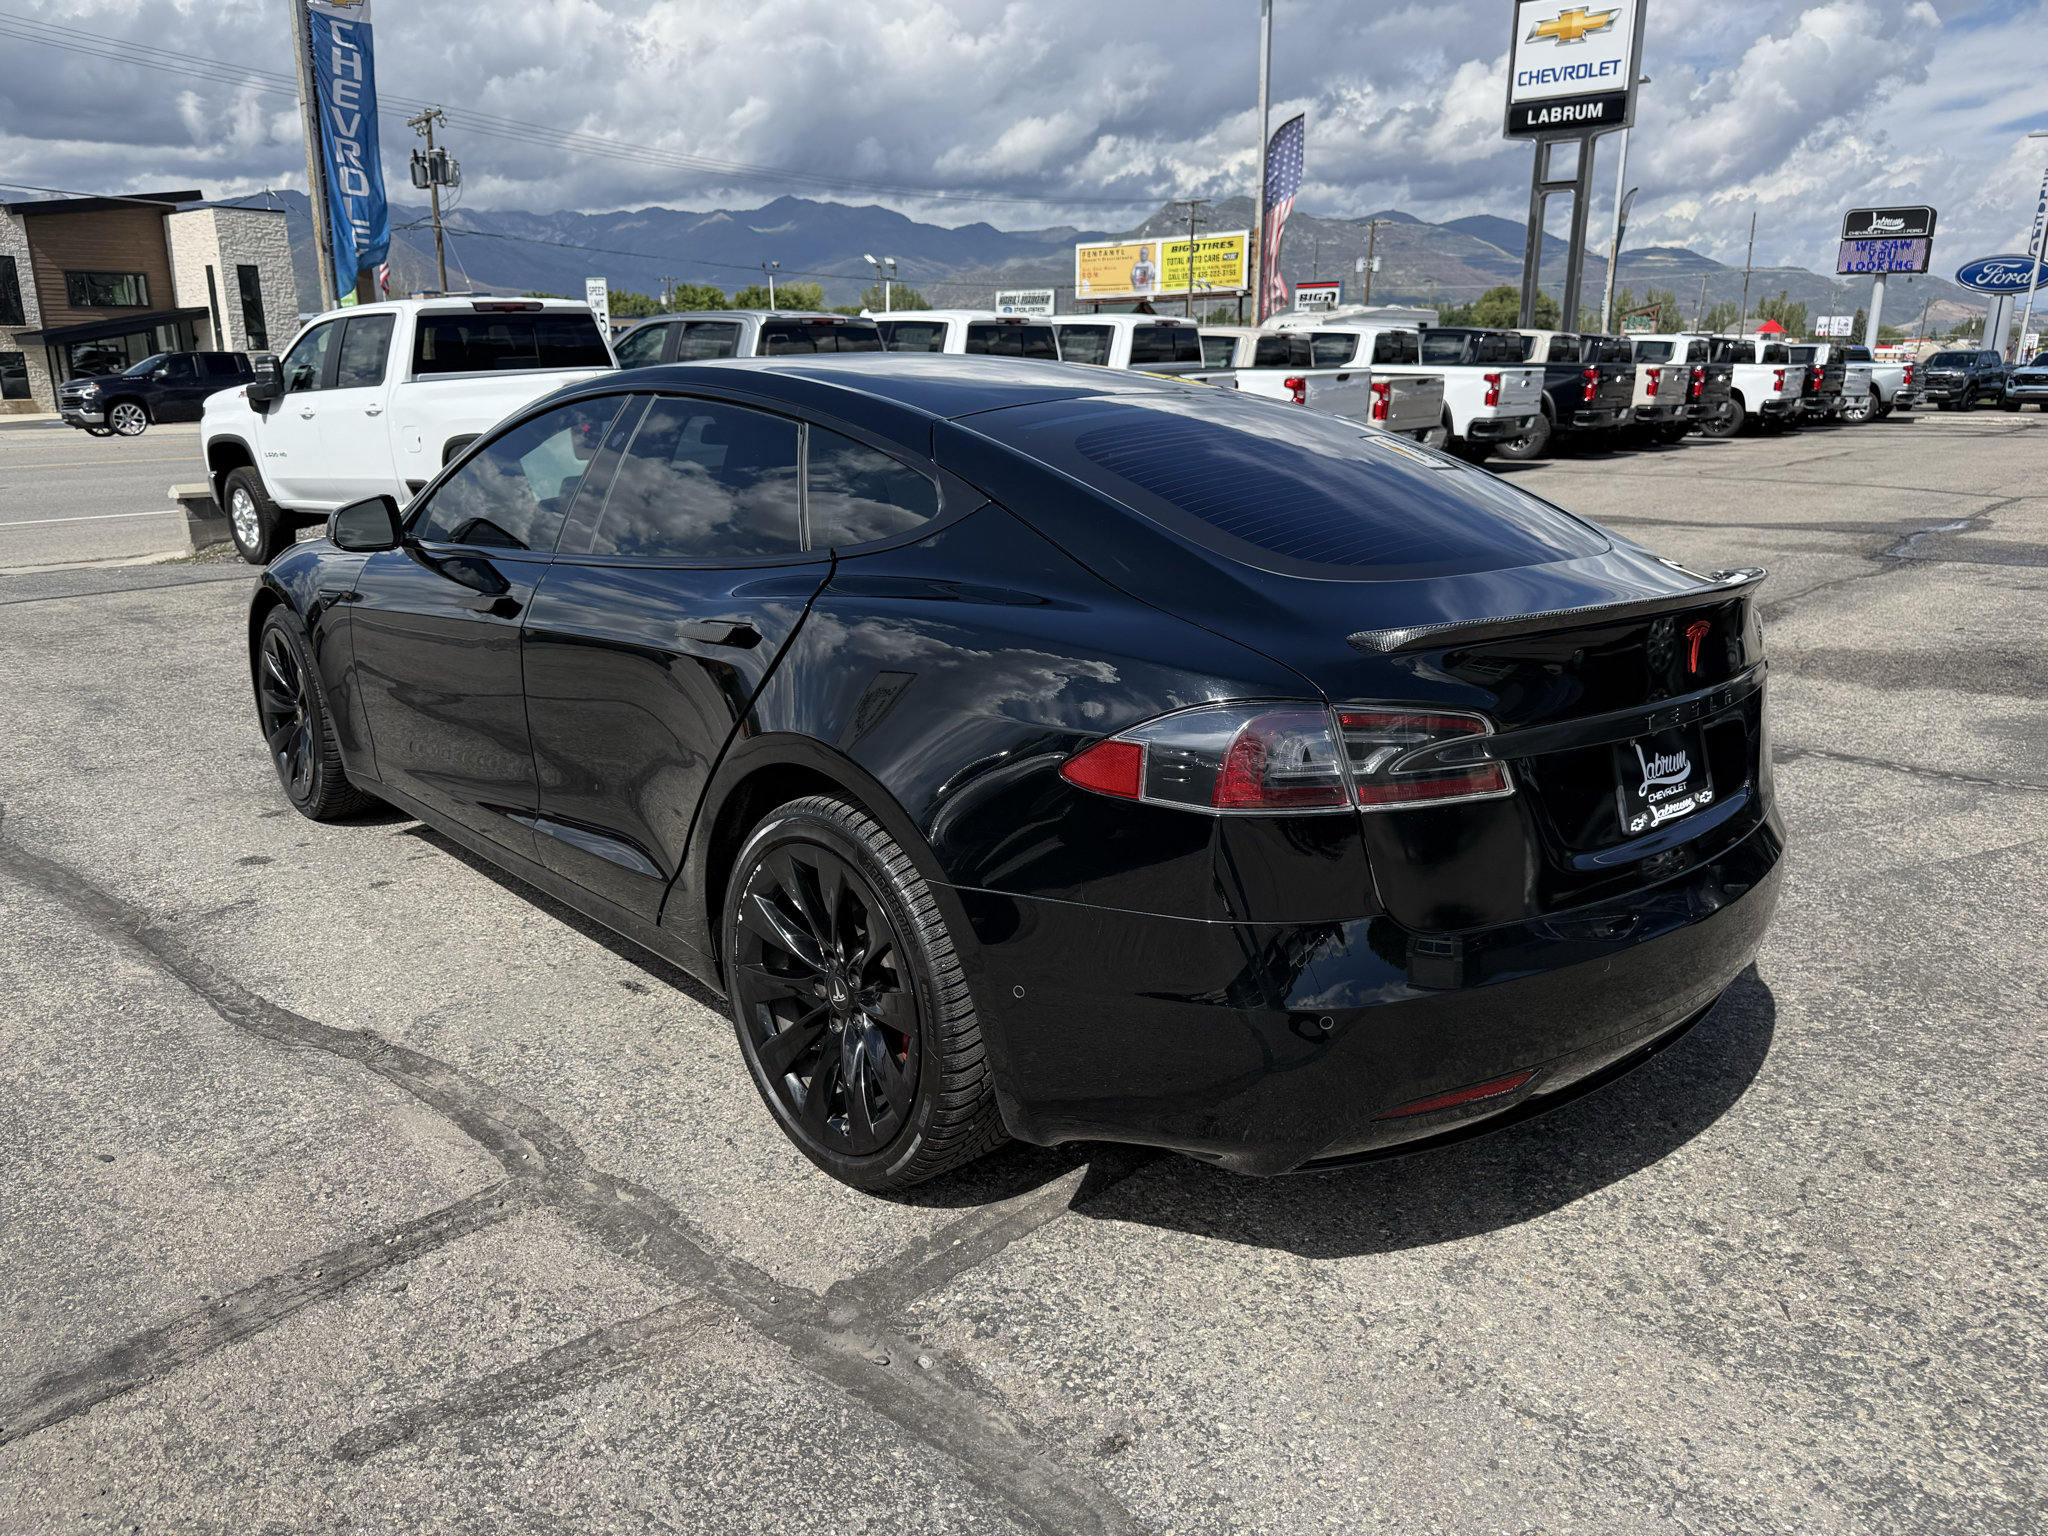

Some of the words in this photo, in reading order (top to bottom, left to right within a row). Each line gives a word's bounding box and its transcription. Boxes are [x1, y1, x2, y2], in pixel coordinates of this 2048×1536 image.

[1518, 59, 1622, 87] CHEVROLET
[1527, 102, 1603, 125] LABRUM
[1171, 244, 1190, 253] BIG
[1201, 240, 1235, 251] TIRES
[1855, 240, 1877, 252] WE
[1879, 239, 1913, 251] SAW
[1167, 257, 1184, 266] TOTAL
[1203, 253, 1220, 262] CARE
[1868, 250, 1897, 261] YOU
[1847, 259, 1914, 272] LOOKING
[1976, 262, 2036, 285] Ford
[1299, 293, 1322, 301] BIG
[1635, 743, 1691, 798] Labrum
[1648, 781, 1687, 803] CHEVROLET
[1648, 797, 1696, 828] Labrum
